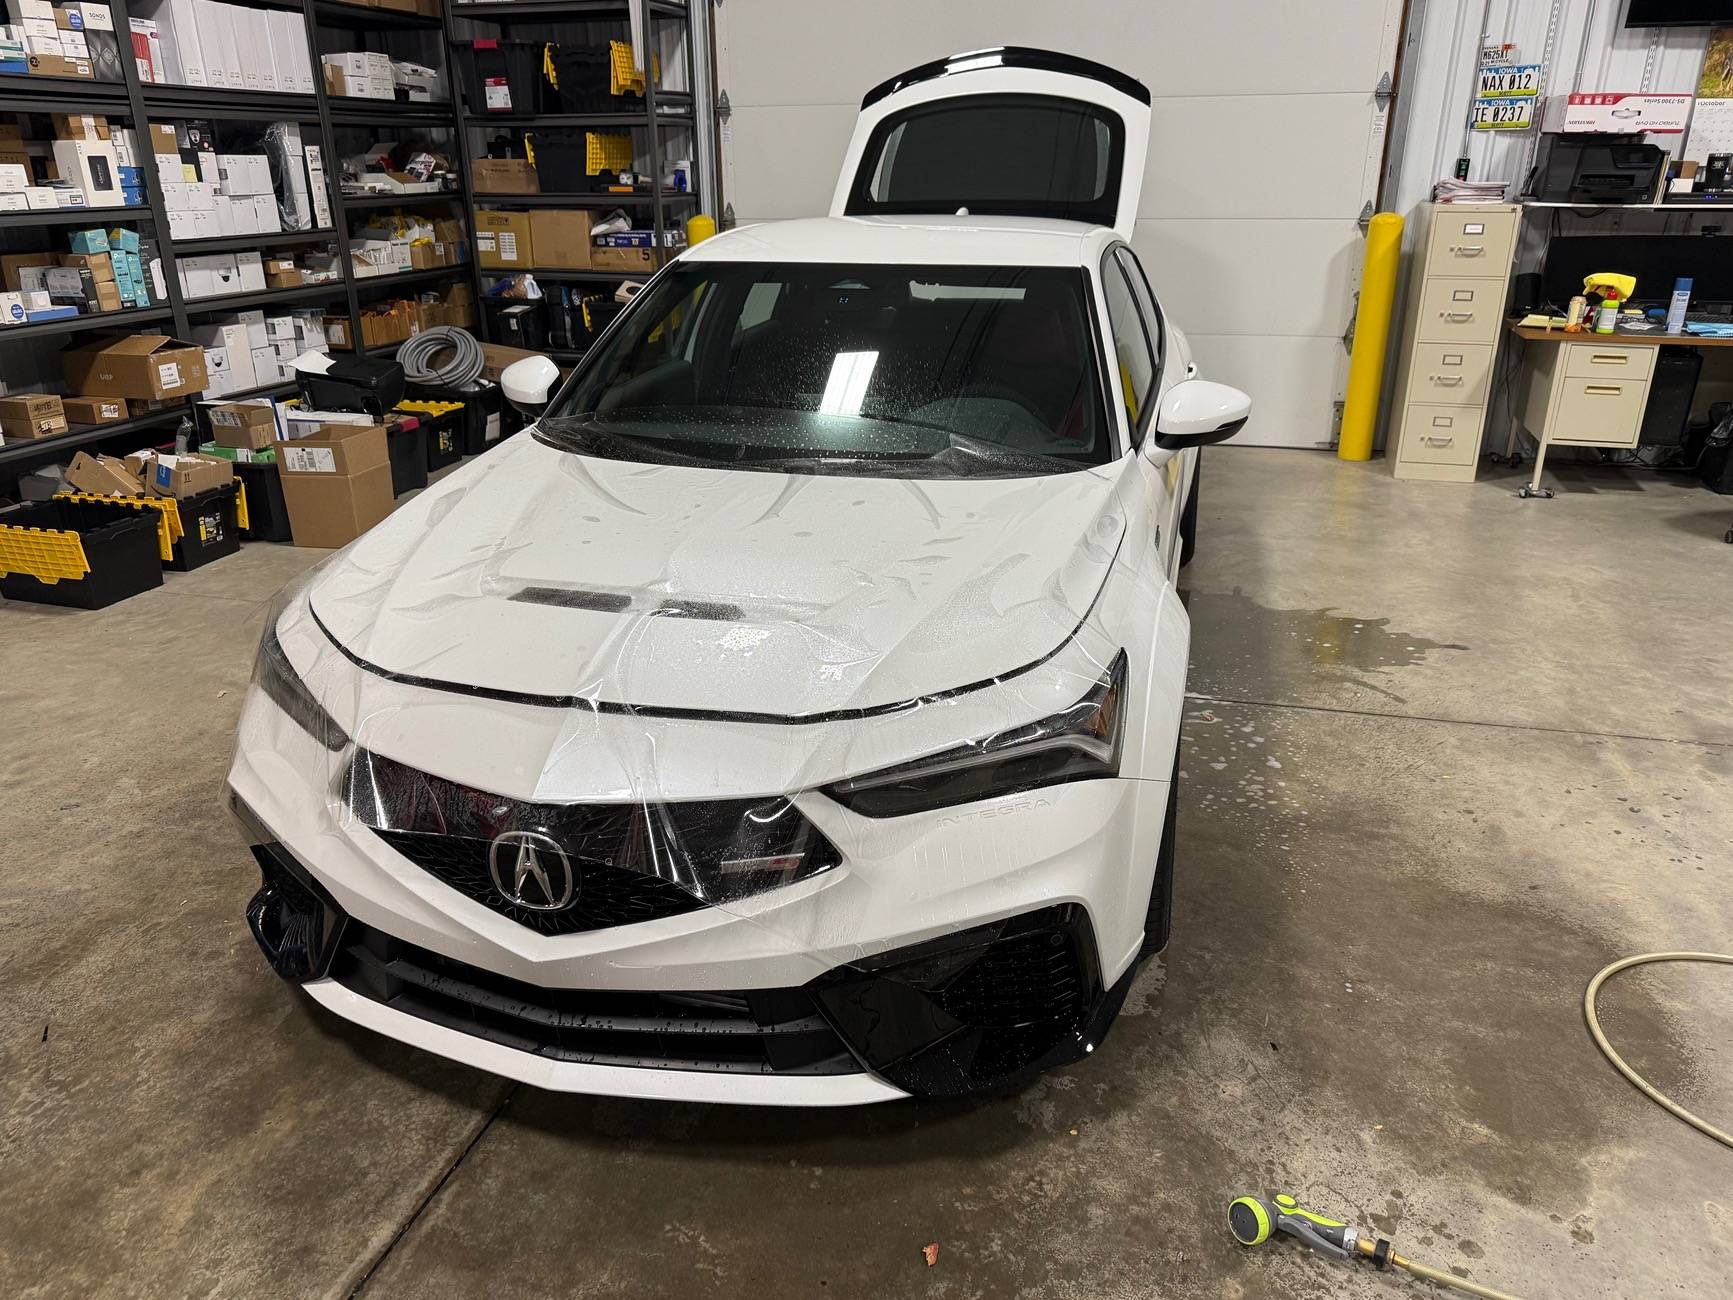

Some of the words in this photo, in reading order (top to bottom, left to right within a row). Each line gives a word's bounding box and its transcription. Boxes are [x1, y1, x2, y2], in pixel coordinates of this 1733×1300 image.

[1482, 75, 1505, 91] NAX
[1508, 74, 1531, 91] 012
[1492, 106, 1524, 122] 0237
[642, 248, 650, 261] 5
[936, 799, 1051, 830] INTEGRA
